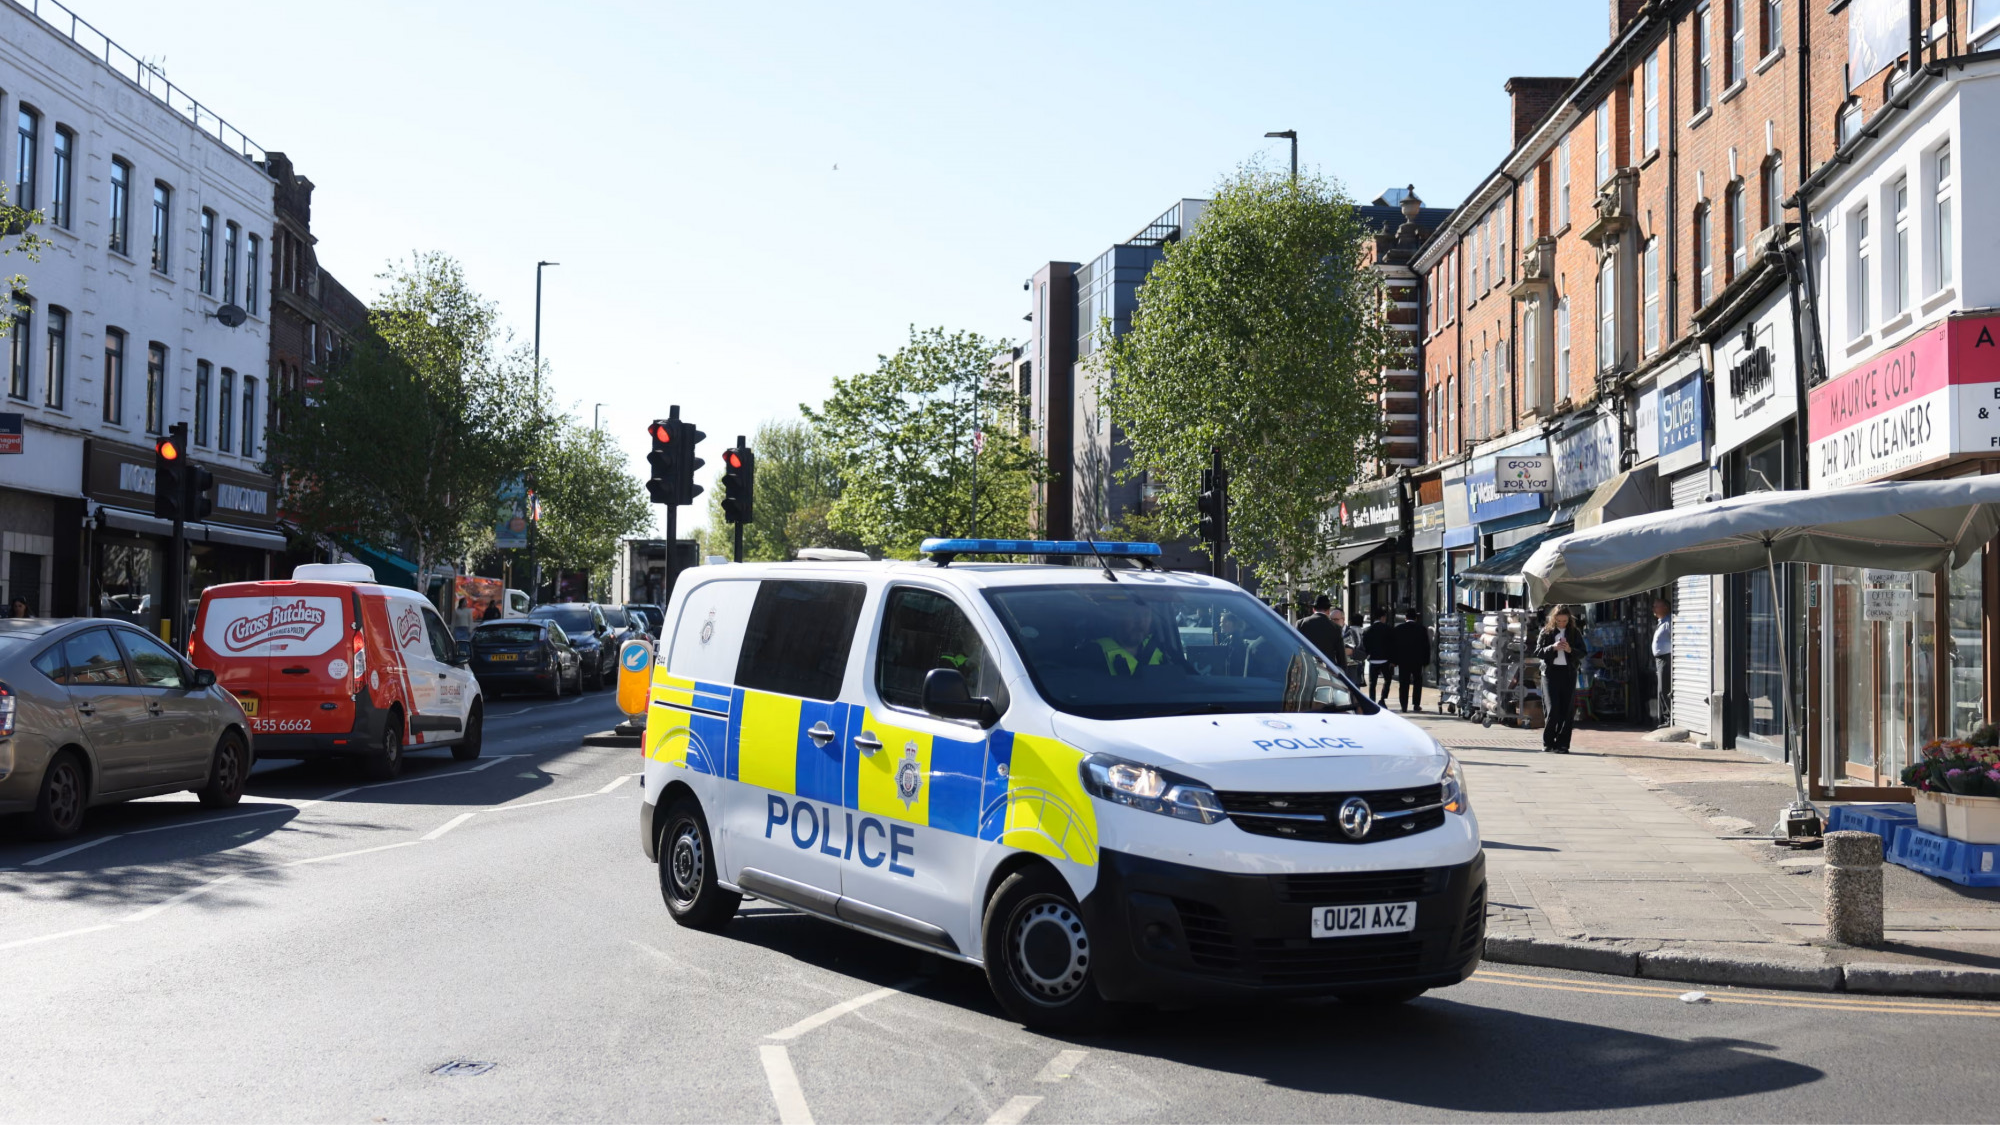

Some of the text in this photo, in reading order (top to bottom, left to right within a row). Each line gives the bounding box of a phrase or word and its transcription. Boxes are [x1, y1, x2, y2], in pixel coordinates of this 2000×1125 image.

[1672, 390, 1681, 402] THE
[1830, 369, 1877, 426] MAURICE
[1884, 350, 1916, 401] COLP
[1663, 394, 1694, 433] SILVER
[1978, 407, 1989, 419] &
[1663, 424, 1695, 448] PLACE
[1821, 401, 1931, 477] 2HR DRY CLEANERS
[1508, 460, 1542, 469] GOOD
[1894, 450, 1923, 469] CURTAINS
[1503, 479, 1548, 490] FOR YOU
[235, 601, 323, 639] Gross Butchers
[253, 719, 312, 731] 455 6662
[1252, 737, 1364, 752] POLICE
[765, 793, 915, 878] POLICE
[1323, 905, 1408, 931] OU21 AXZ
